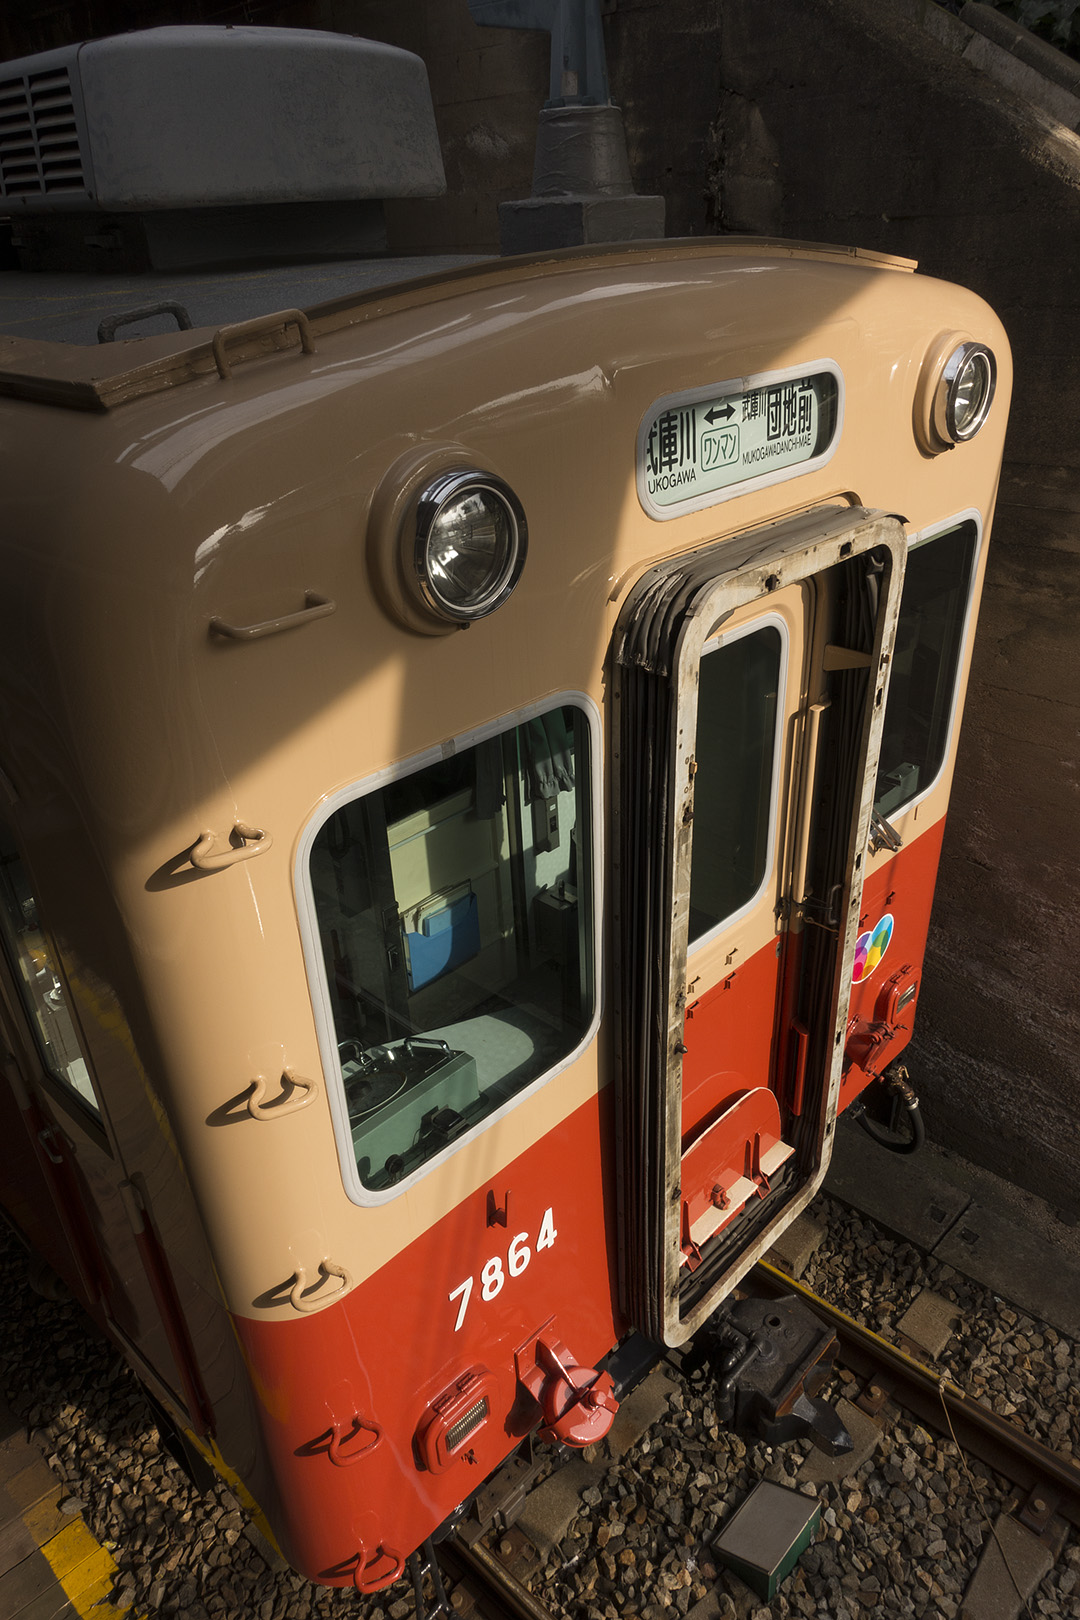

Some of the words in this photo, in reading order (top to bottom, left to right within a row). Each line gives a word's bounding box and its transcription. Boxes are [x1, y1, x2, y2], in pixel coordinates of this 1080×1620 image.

[741, 378, 813, 441] 武庫川団地前
[704, 433, 737, 465] ワンマン
[742, 433, 812, 466] MUKOGAWADANCHI-MAE
[647, 467, 697, 494] UKOGAWA
[449, 1206, 558, 1332] 7864
